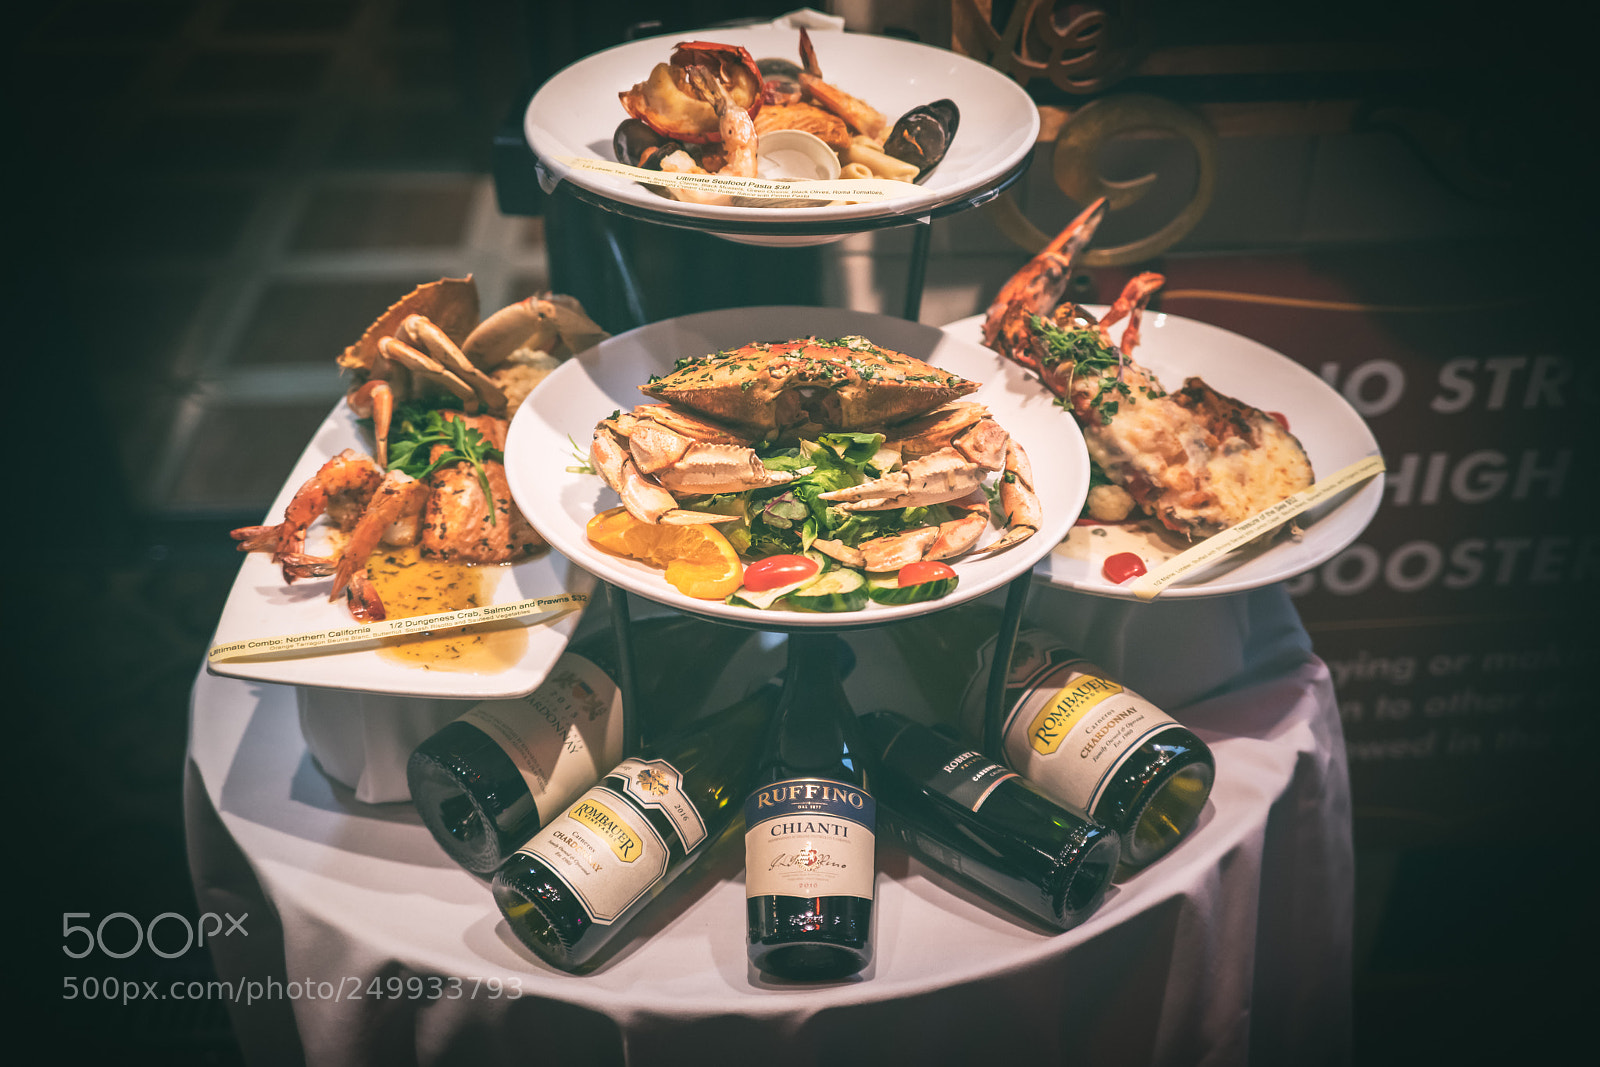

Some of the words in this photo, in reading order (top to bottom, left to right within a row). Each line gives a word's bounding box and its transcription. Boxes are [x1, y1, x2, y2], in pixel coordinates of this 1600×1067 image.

[676, 175, 710, 184] Ultimate
[711, 178, 747, 188] Seafood
[748, 181, 772, 190] Pasta
[209, 644, 246, 657] Ultimate
[247, 638, 283, 649] Combo:
[286, 633, 326, 644] Northern
[328, 627, 371, 638] California
[389, 621, 403, 629] 1/2
[405, 614, 455, 628] Dungeness
[457, 610, 481, 620] Crab,
[483, 604, 517, 615] Salmon
[519, 600, 536, 610] and
[537, 596, 569, 607] Prawns
[295, 639, 326, 649] Tarragon
[1034, 677, 1117, 746] ROMBAUER
[1085, 709, 1115, 734] Carneros
[1080, 706, 1138, 759] CHARDONNAY
[758, 784, 863, 809] RUFFINO
[673, 804, 690, 822] 2016
[571, 831, 596, 853] Carneros
[574, 802, 634, 859] ROMBAUER
[771, 822, 848, 838] CHIANTI
